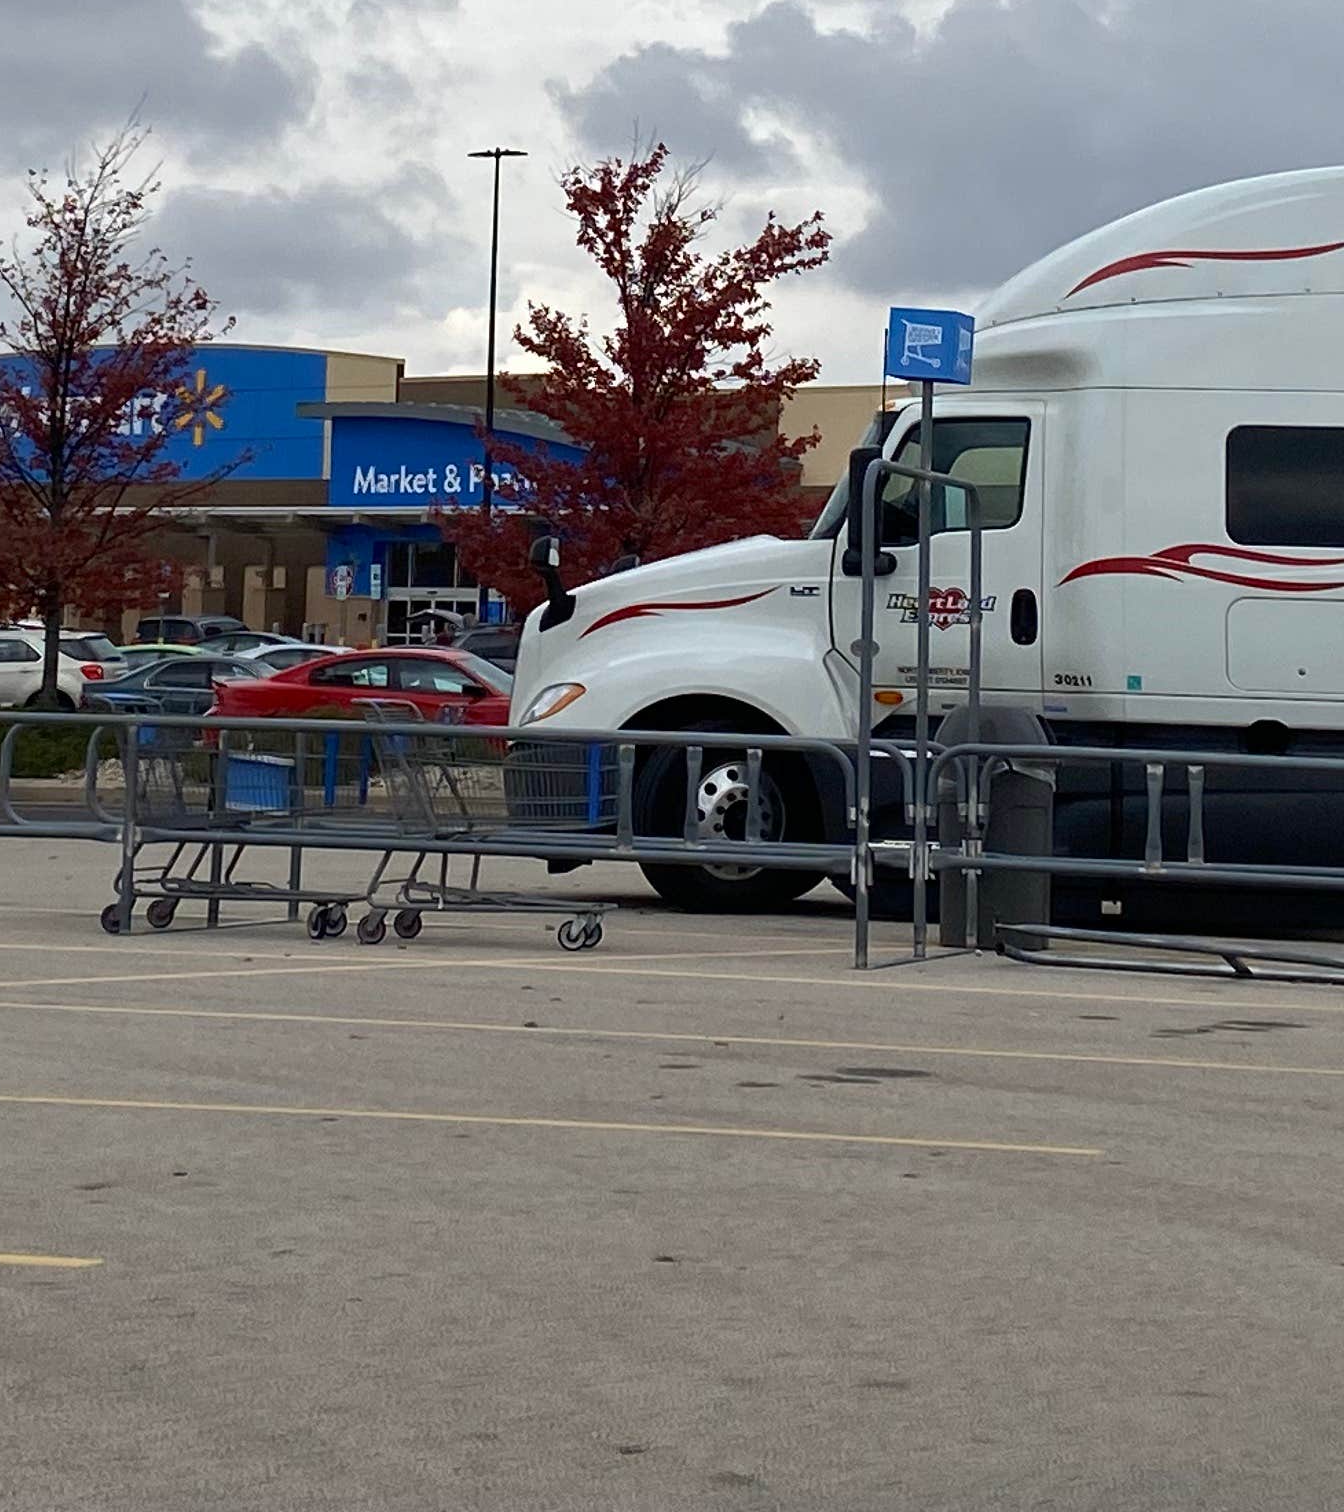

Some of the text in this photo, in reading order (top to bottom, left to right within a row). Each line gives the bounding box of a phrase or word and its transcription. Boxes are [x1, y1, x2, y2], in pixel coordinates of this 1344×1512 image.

[353, 464, 438, 494] Market
[443, 464, 461, 494] &
[887, 593, 997, 612] HertLad
[1054, 674, 1092, 687] 30211
